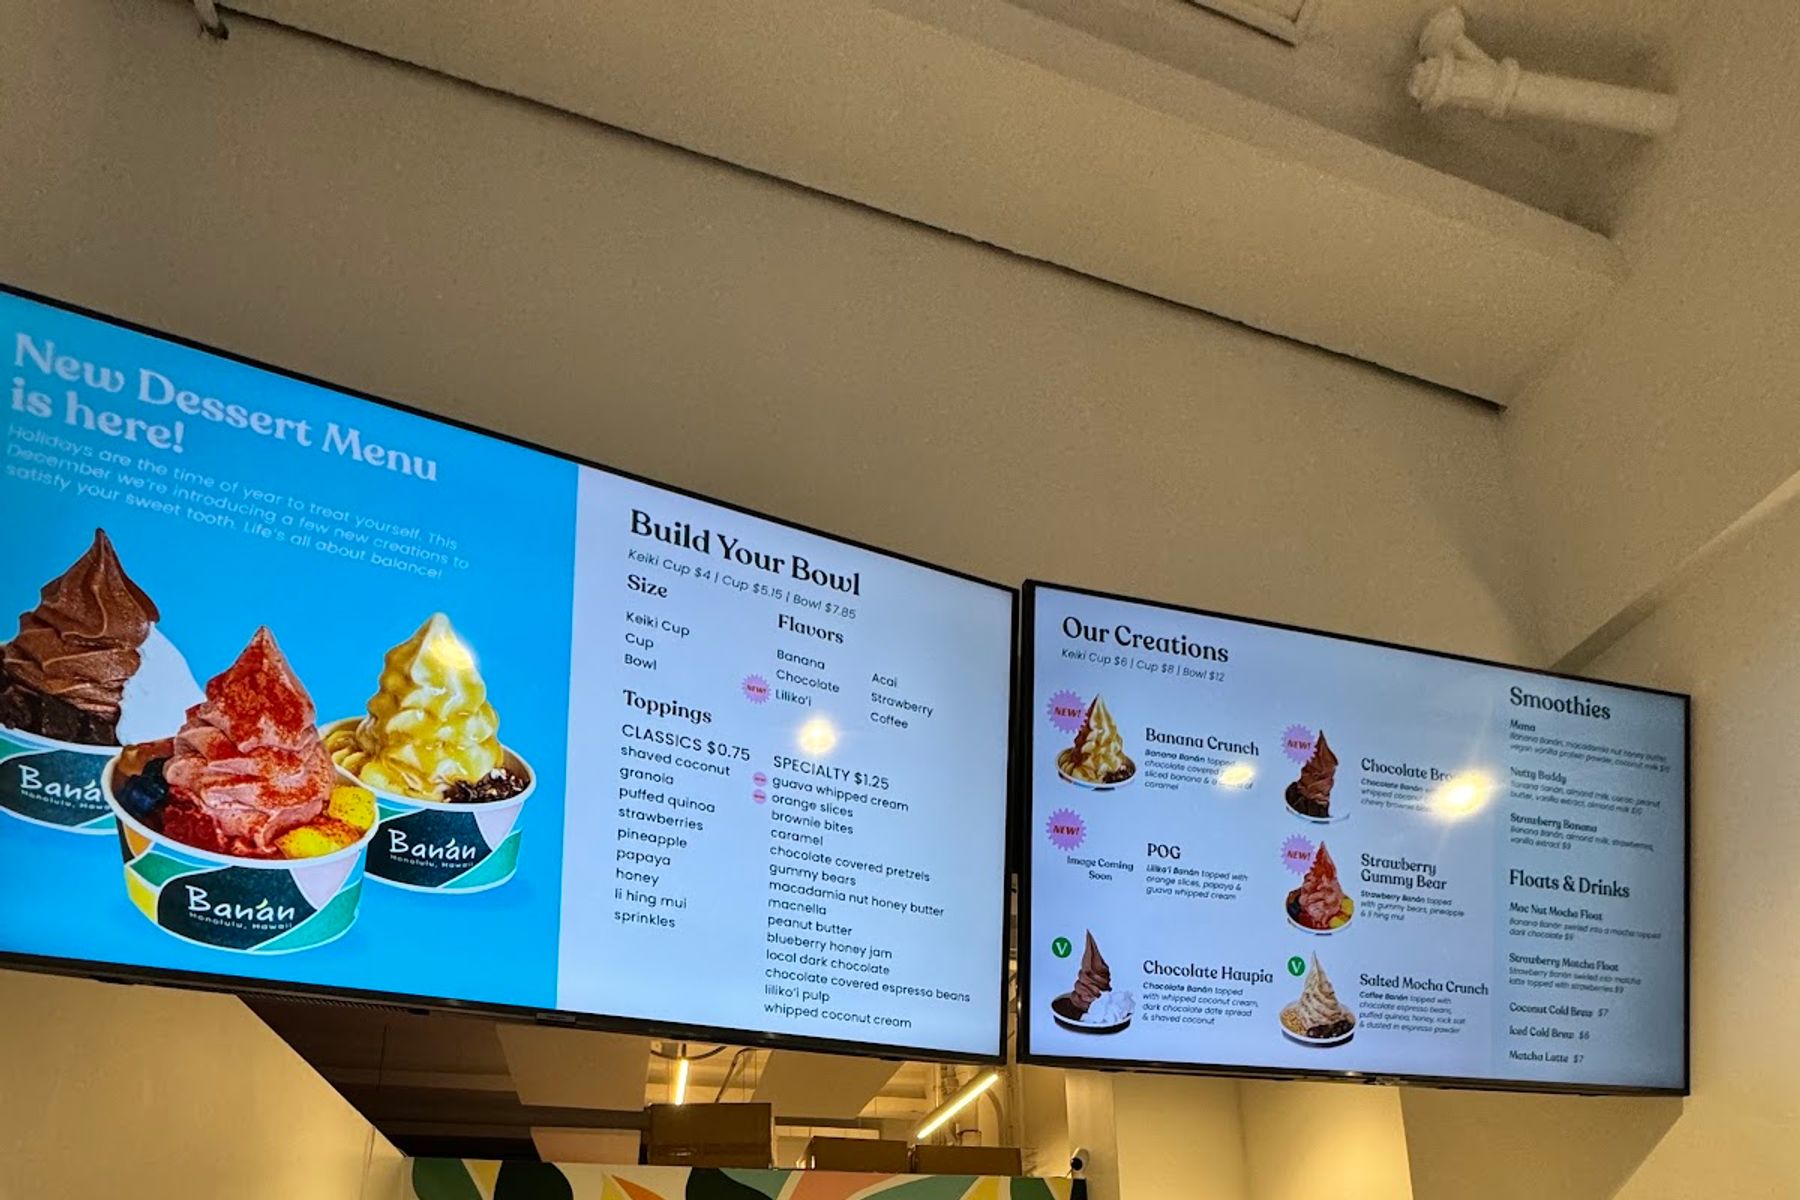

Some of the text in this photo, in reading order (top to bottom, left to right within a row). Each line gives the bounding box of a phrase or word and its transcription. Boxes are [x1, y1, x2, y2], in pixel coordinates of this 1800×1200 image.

[12, 376, 184, 453] is here!
[15, 332, 437, 481] New Dessert Menu
[9, 425, 92, 457] Holidays
[98, 450, 132, 466] are
[137, 458, 168, 475] the
[173, 467, 215, 488] time
[243, 488, 281, 504] year
[309, 502, 349, 522] treat
[428, 533, 457, 550] This
[7, 444, 110, 479] December
[173, 488, 277, 523] introducing
[299, 516, 329, 534] few
[334, 527, 369, 543] new
[373, 538, 448, 564] creations
[7, 465, 71, 490] satisfy
[77, 482, 120, 500] your
[125, 493, 181, 516] sweet
[290, 534, 311, 547] all
[315, 540, 366, 559] about
[370, 552, 442, 578] balance!
[631, 508, 859, 596] Build Your Bowl
[627, 574, 667, 598] Size
[628, 548, 856, 619] Keiki Cup $4 Cup $5.15 Bowl $7.85
[626, 611, 690, 638] Keiki Cup
[778, 613, 843, 644] Flavors
[624, 632, 654, 650] Cup
[1062, 616, 1228, 662] Our Creations
[624, 653, 657, 670] Bowl
[776, 649, 825, 670] Banana
[1061, 647, 1225, 682] Keiki Cup $6 Cup $8 Bowl $12
[776, 669, 840, 693] Chocolate
[622, 689, 712, 724] Toppings
[871, 692, 933, 718] Strawberry
[1055, 706, 1081, 718] NEW!
[1510, 686, 1611, 720] Smoothies
[870, 712, 908, 729] Coffee
[621, 724, 750, 761] CLASSICS $0.75
[1145, 727, 1259, 756] Banana Crunch
[620, 745, 730, 776] shaved coconut
[773, 755, 889, 790] SPECIALTY $1.25
[1361, 757, 1427, 779] Chocolate
[619, 767, 674, 785] granola
[619, 787, 715, 813] puffed quinoa
[771, 794, 817, 812] orange
[820, 803, 853, 817] slices
[772, 777, 813, 792] guava
[815, 785, 868, 803] whipped
[870, 797, 909, 811] cream
[618, 807, 703, 831] strawberries
[771, 810, 853, 834] brownie bites
[1053, 824, 1080, 836] NEW!
[387, 828, 477, 861] Banán
[617, 828, 687, 848] pineapple
[770, 829, 823, 846] caramel
[616, 849, 671, 867] papaya
[1147, 842, 1181, 859] POG
[769, 845, 930, 882] chocolate covered pretzels
[769, 863, 856, 886] gummy bears
[1066, 855, 1134, 872] Image Coming
[1088, 869, 1112, 880] Soon
[1360, 853, 1436, 877] Strawberry
[615, 867, 659, 887] honey
[1360, 868, 1447, 890] Gummy Bear
[1509, 868, 1630, 898] Floats & Drinks
[184, 884, 296, 922] Banán
[614, 888, 687, 908] li hing mui
[768, 898, 826, 915] macnella
[769, 881, 944, 916] macadamia nut honey butter
[614, 911, 675, 928] sprinkles
[767, 916, 852, 935] peanut butter
[766, 932, 892, 959] blueberry honey jam
[766, 948, 890, 975] local dark chocolate
[1143, 959, 1273, 985] Chocolate Haupia
[764, 967, 970, 1002] chocolate covered espresso beans
[1359, 973, 1489, 995] Salted Mocha Crunch
[802, 990, 830, 1004] pulp
[763, 1003, 912, 1028] whipped coconut cream
